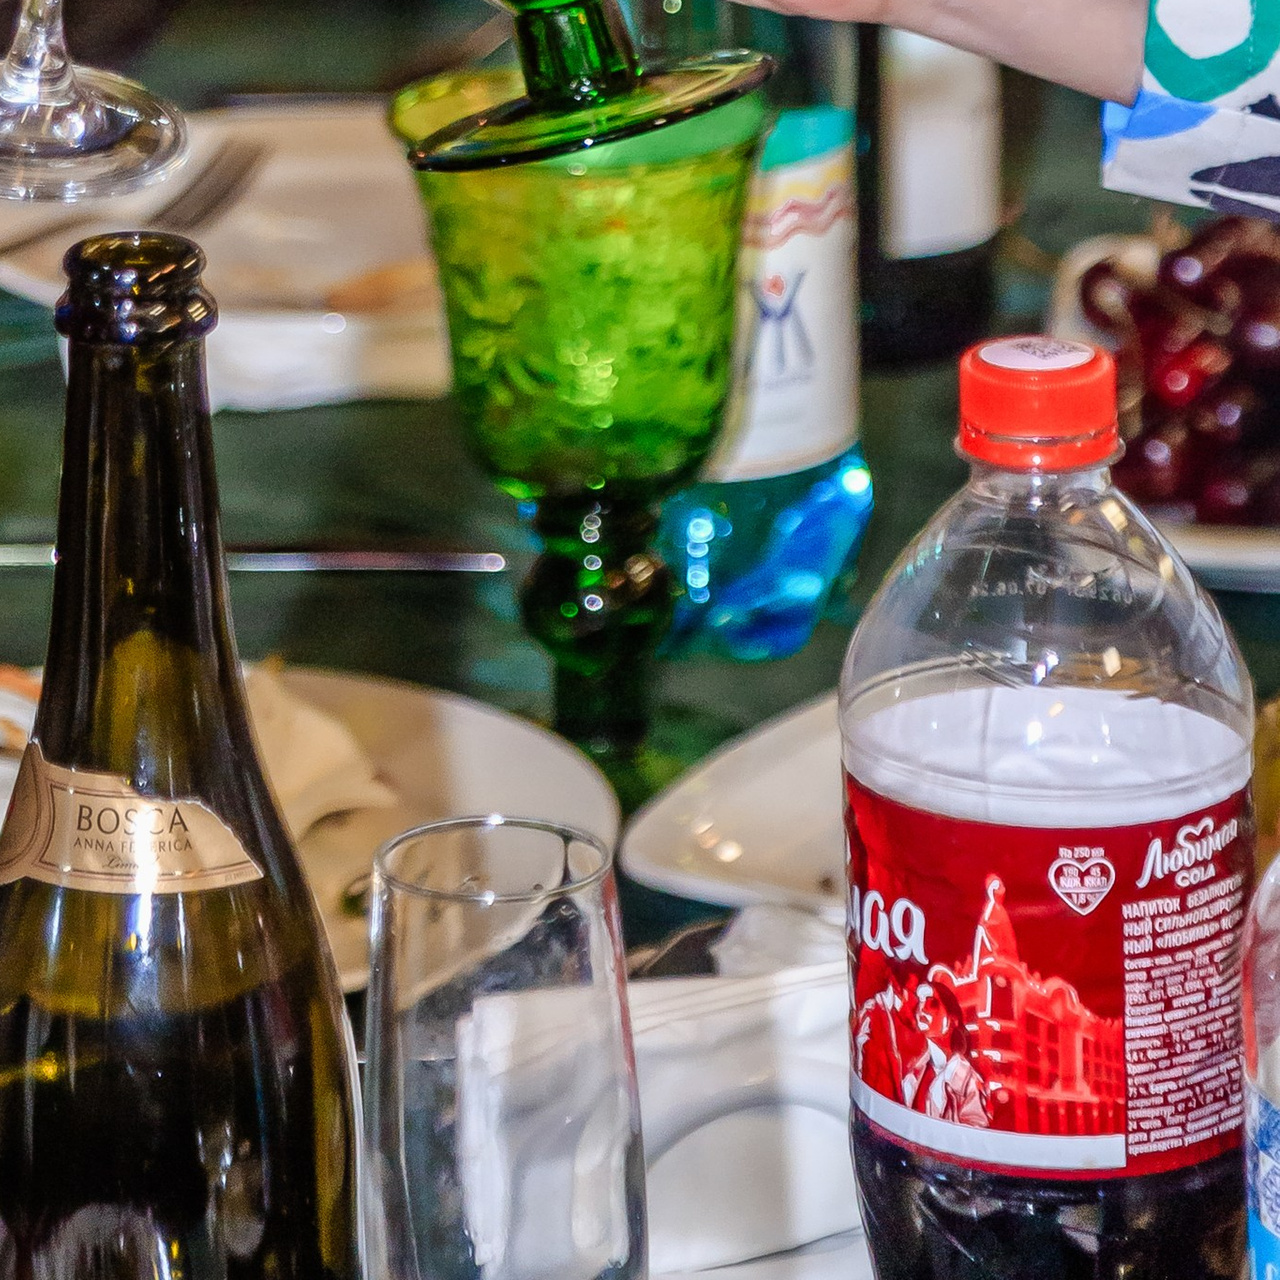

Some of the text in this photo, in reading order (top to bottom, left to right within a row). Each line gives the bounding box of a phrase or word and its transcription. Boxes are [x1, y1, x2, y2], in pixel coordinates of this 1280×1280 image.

[73, 837, 116, 853] ANNA
[1074, 847, 1091, 858] 250
[1175, 863, 1216, 887] COLA
[1122, 897, 1181, 920] НАПИТОК
[1123, 916, 1153, 937] НЫЙ
[1123, 935, 1154, 955] НЫЙ
